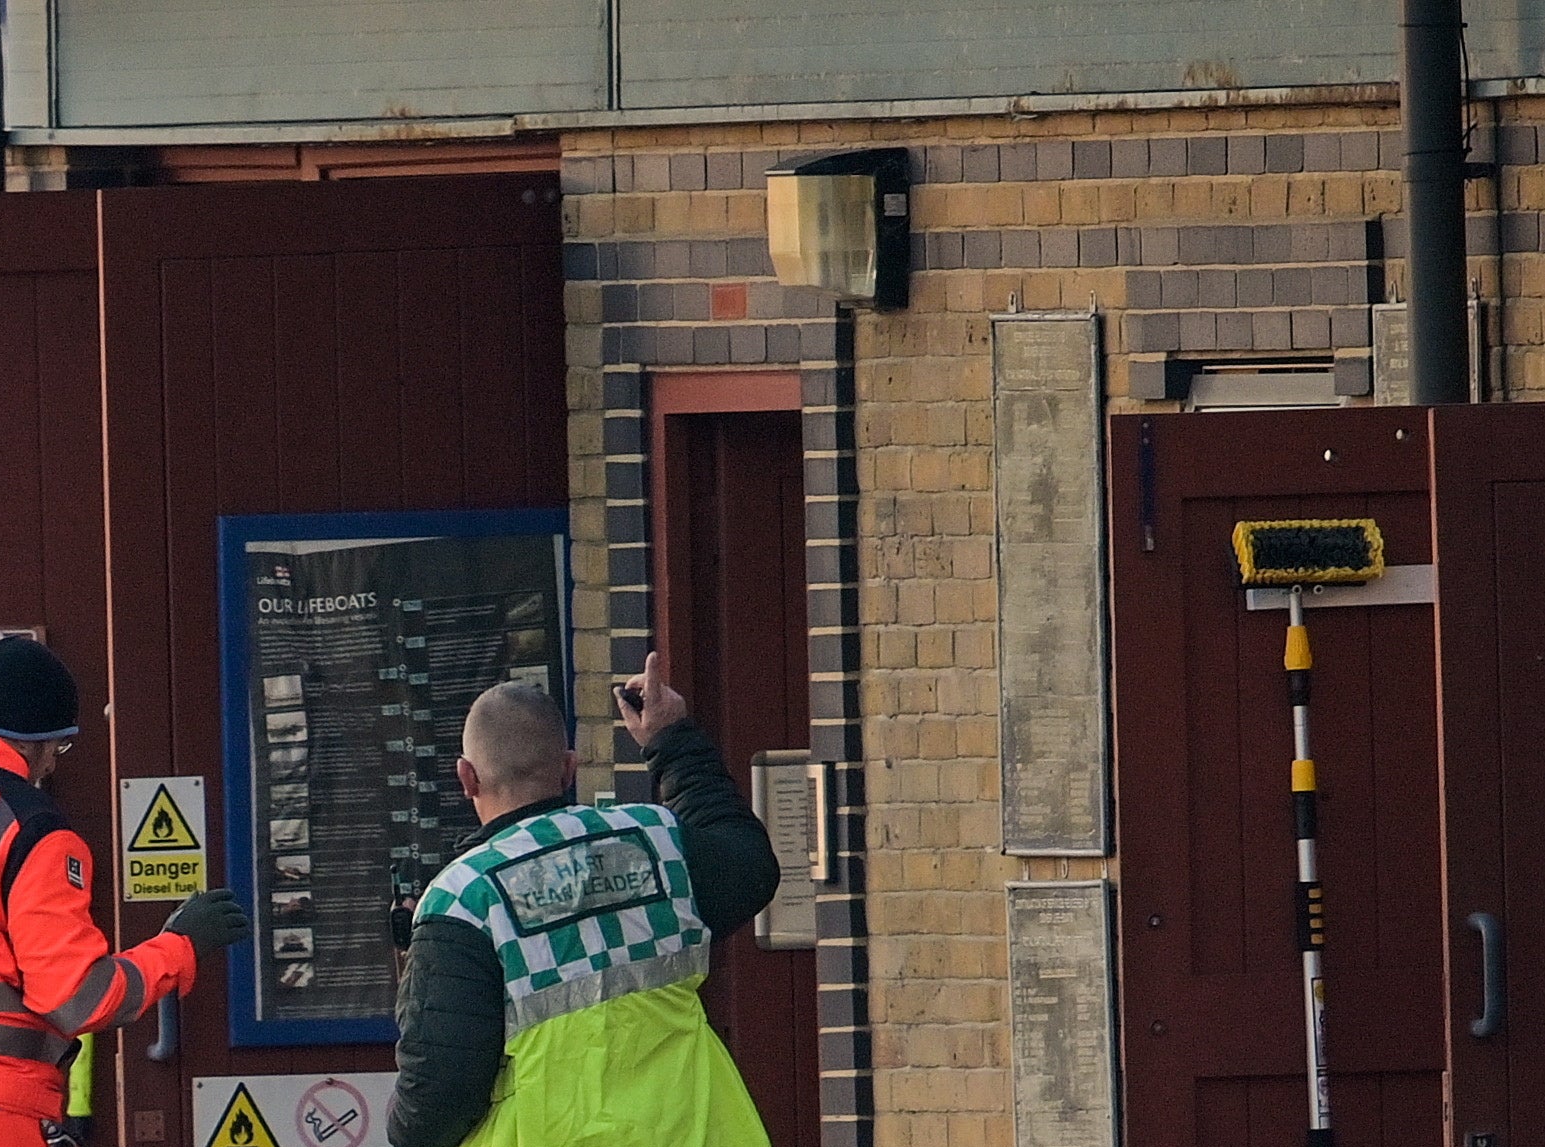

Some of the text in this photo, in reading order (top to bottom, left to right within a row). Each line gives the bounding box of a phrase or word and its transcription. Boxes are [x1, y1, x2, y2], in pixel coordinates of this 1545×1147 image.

[258, 598, 293, 614] OUR
[130, 860, 200, 879] Danger
[554, 854, 604, 879] HART
[133, 882, 198, 895] Diesel fuel
